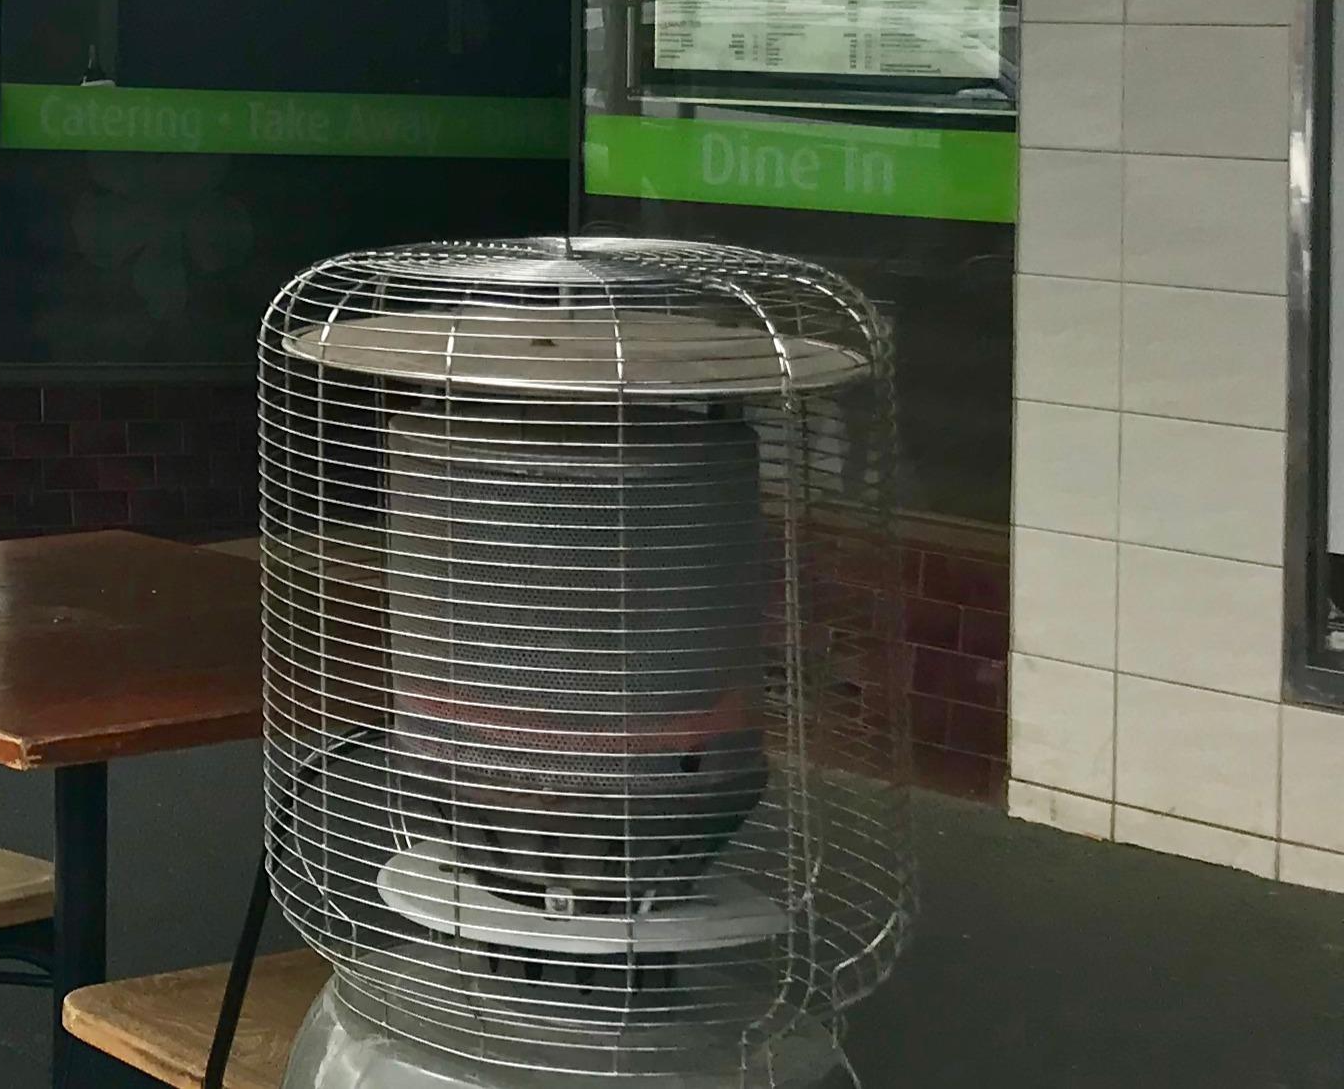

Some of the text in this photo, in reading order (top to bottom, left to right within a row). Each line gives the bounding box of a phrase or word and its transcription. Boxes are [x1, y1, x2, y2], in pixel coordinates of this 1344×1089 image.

[39, 95, 201, 153] Catering
[247, 101, 330, 146] Take
[700, 131, 897, 195] Dine In
